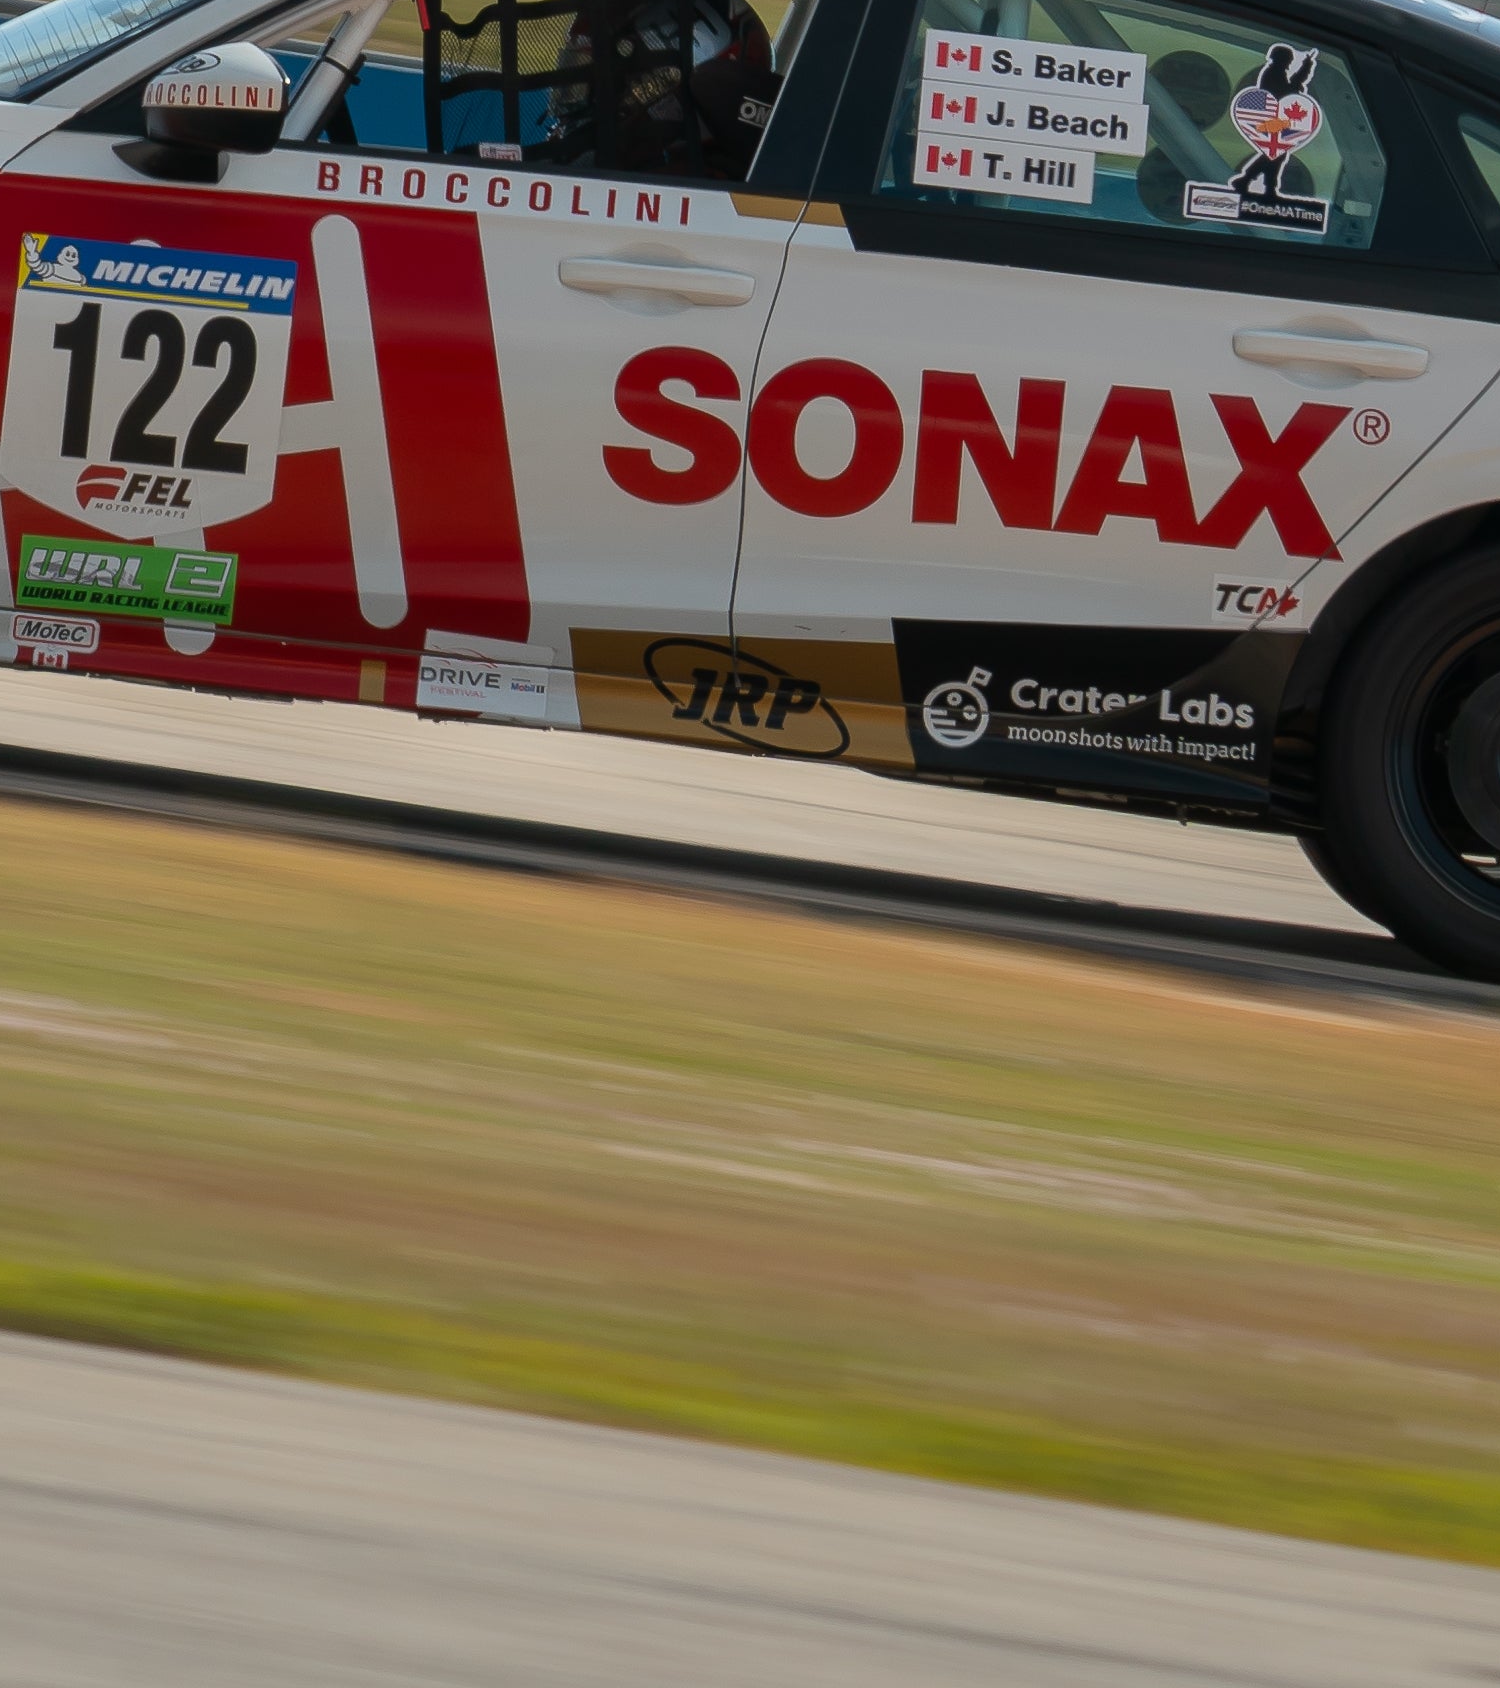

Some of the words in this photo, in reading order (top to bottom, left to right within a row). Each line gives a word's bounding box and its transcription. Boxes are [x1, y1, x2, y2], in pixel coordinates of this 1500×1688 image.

[991, 49, 1022, 76] S.
[1034, 53, 1132, 89] Baker
[146, 82, 274, 109] ROCCOLINI
[740, 102, 773, 125] OM
[986, 101, 1015, 128] J.
[1027, 104, 1129, 141] Beach
[983, 152, 1012, 181] T.
[1023, 156, 1077, 188] Hill
[316, 160, 690, 227] BROCCOLINI
[92, 259, 294, 300] MICHELIN
[53, 301, 258, 475] 122
[121, 473, 192, 508] FEL
[94, 502, 186, 520] MOTORSPORTS
[25, 548, 143, 591] WRL
[22, 586, 87, 603] WORLD
[90, 591, 160, 610] RACING
[162, 599, 230, 617] LEAGUE
[21, 620, 87, 643] MoTeC
[420, 666, 502, 689] DRIVE
[672, 667, 821, 730] JRP
[1010, 678, 1147, 714] Crater
[1159, 689, 1254, 729] Labs
[1007, 725, 1123, 750] moonshots
[1126, 735, 1173, 754] with
[1177, 736, 1256, 762] impact!
